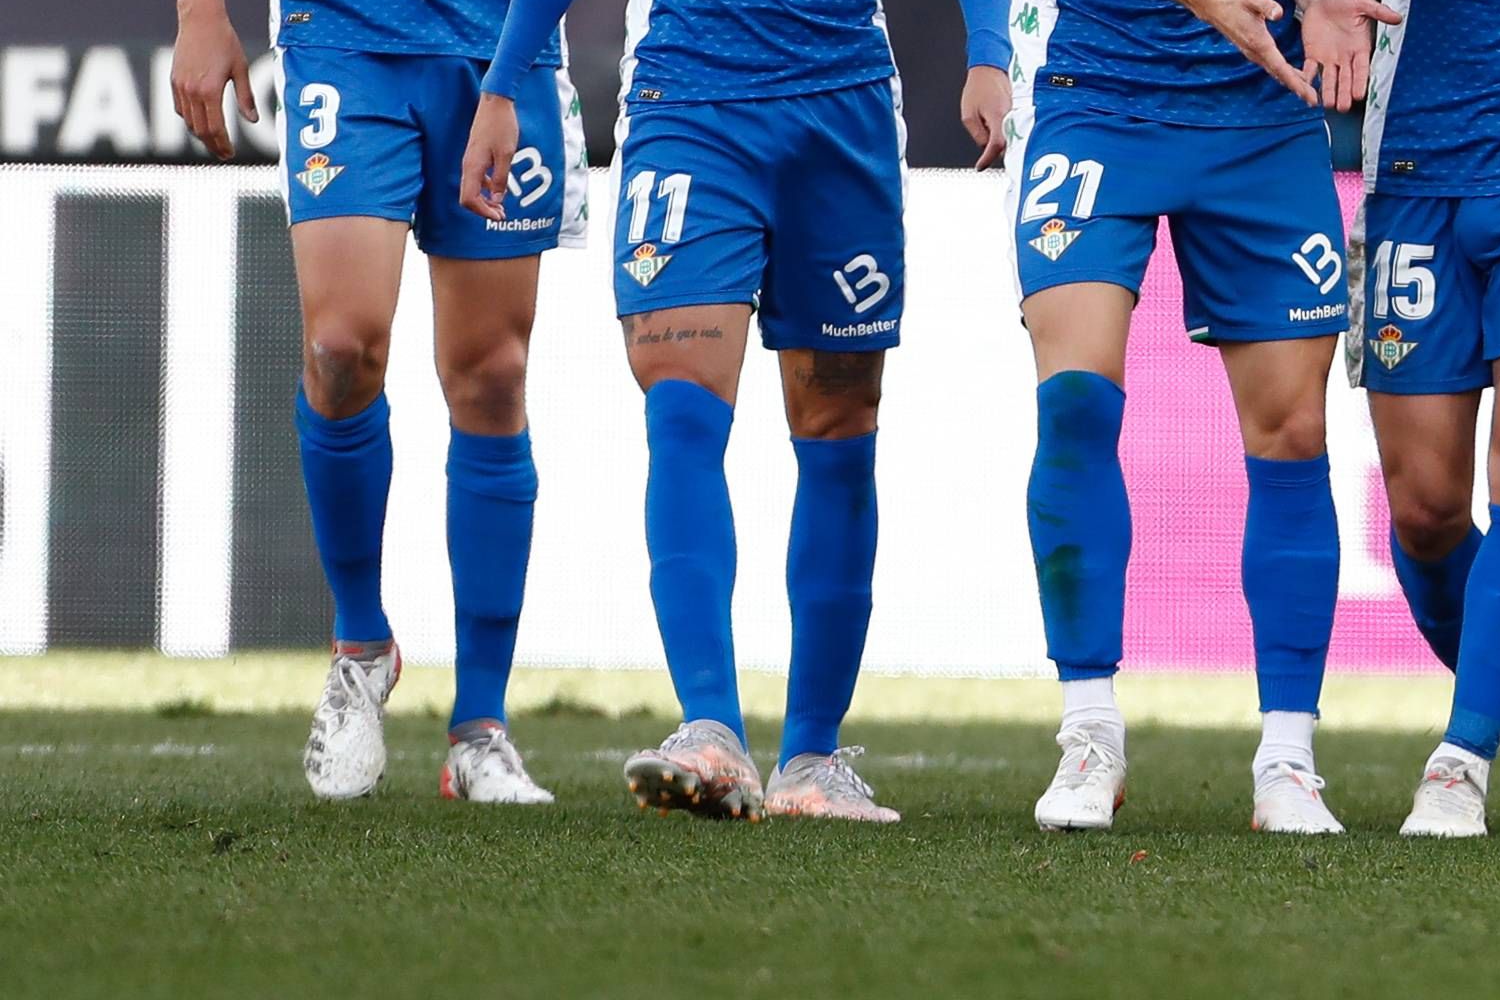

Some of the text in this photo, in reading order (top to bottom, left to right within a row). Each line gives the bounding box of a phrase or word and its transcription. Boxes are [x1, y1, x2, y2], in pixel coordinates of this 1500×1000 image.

[299, 82, 341, 149] 3
[486, 216, 555, 231] MuchBetter
[626, 169, 692, 244] 11
[1020, 152, 1105, 225] 21
[1372, 240, 1436, 320] 15
[822, 319, 897, 338] MuchBetter
